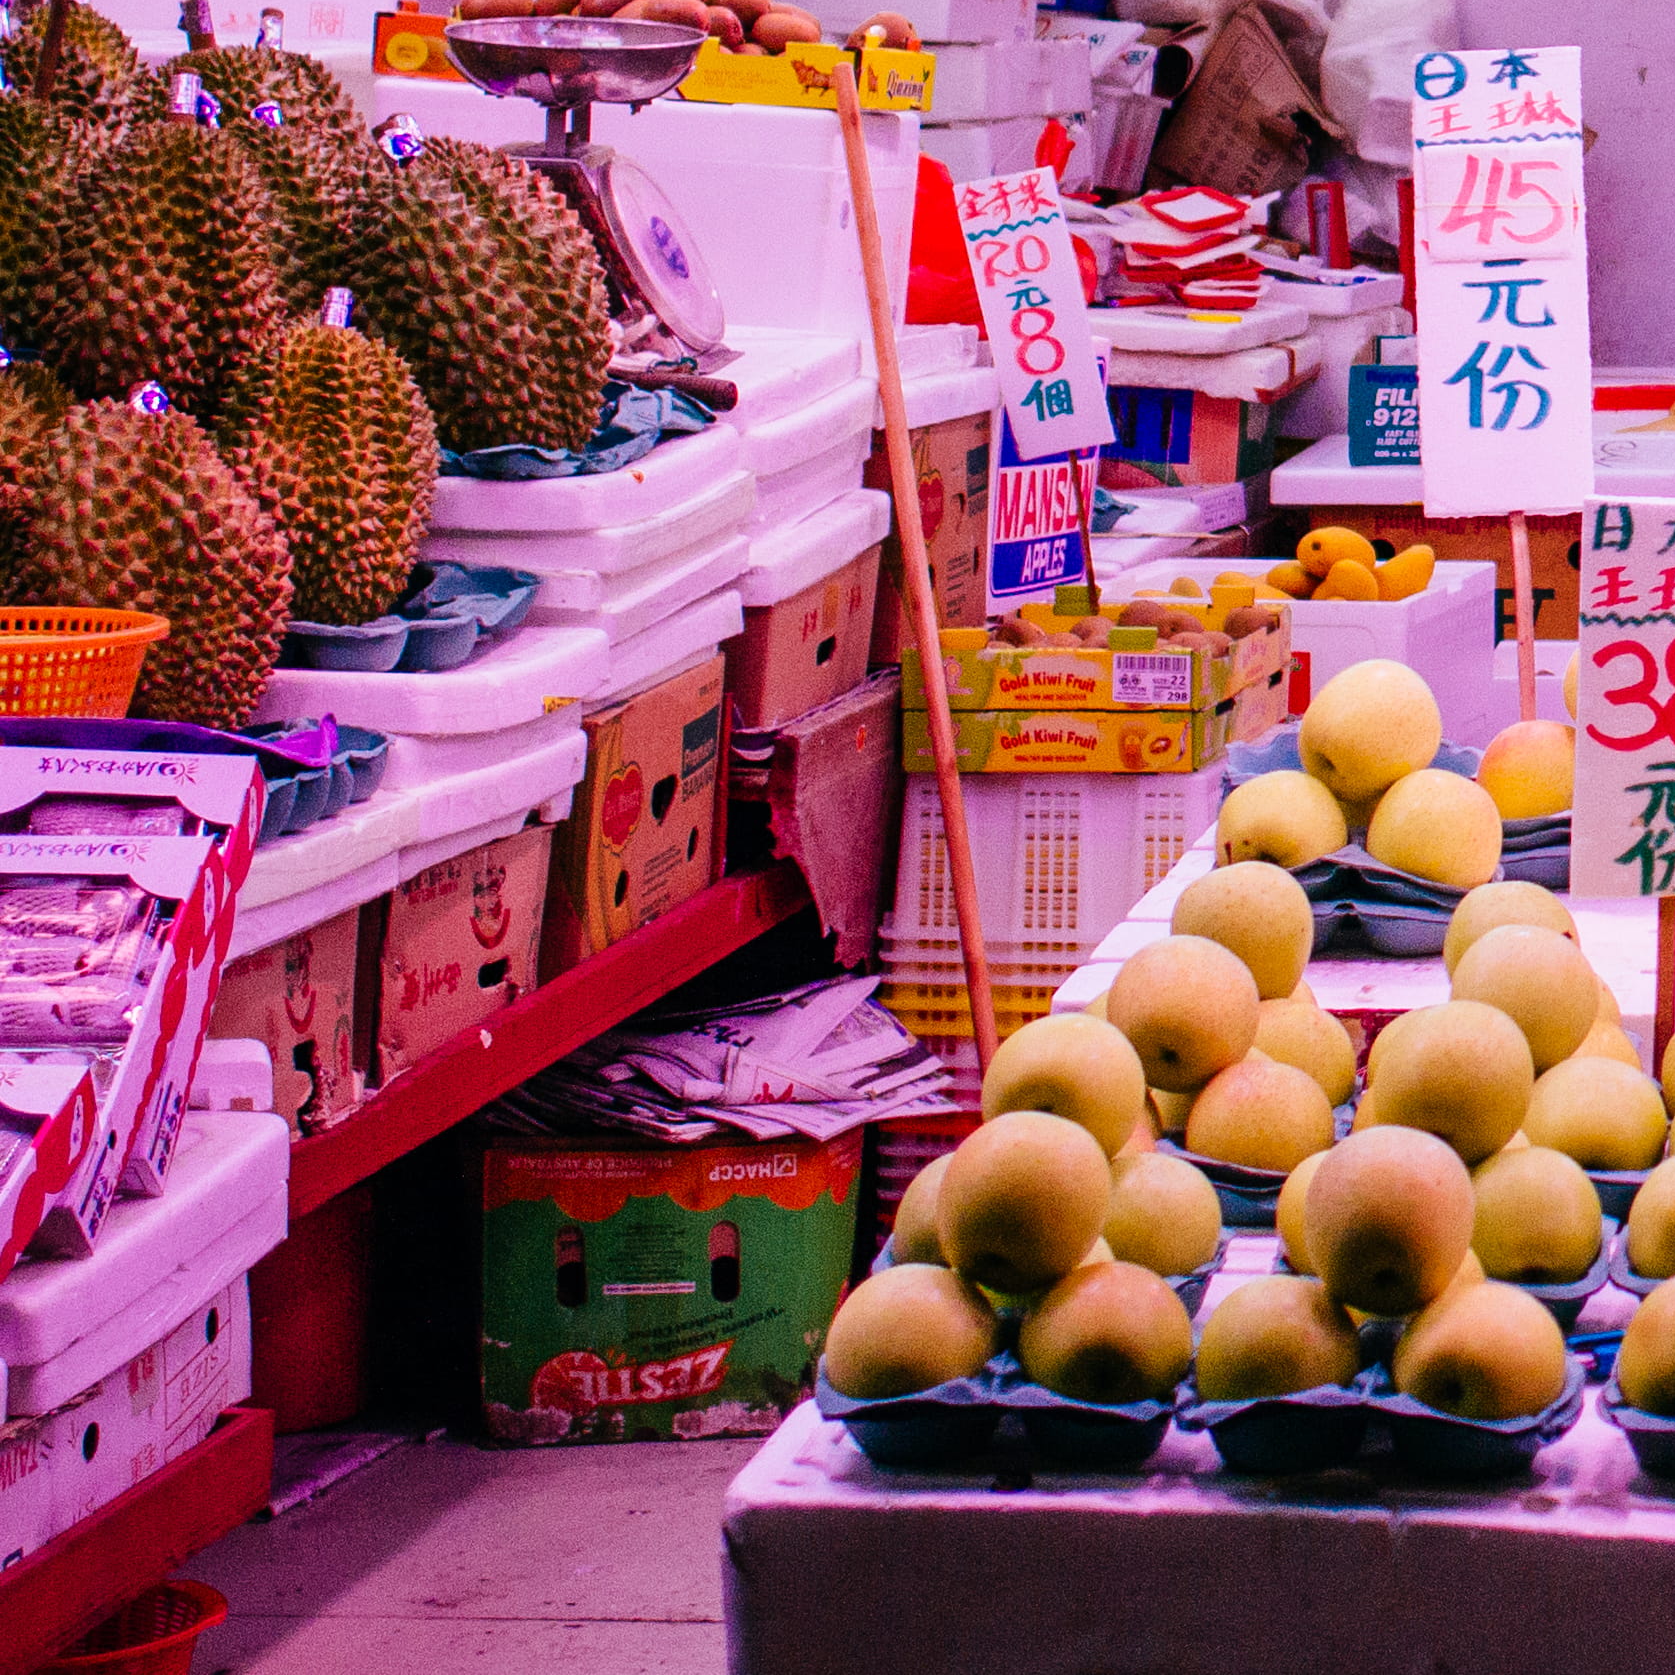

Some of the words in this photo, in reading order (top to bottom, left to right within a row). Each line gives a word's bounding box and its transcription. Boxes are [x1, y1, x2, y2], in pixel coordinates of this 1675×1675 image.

[1416, 50, 1540, 101] 日本
[1429, 99, 1575, 136] 王琳
[1439, 155, 1566, 248] 45
[1022, 539, 1067, 584] APPLES
[999, 673, 1030, 692] Gold
[1032, 671, 1062, 686] Kiwi
[1065, 673, 1096, 693] Fruit
[1171, 675, 1187, 686] 22
[1167, 691, 1188, 702] 298
[1000, 730, 1031, 751] Gold
[1033, 729, 1063, 744] Kiwi
[1066, 731, 1098, 751] Fruit
[709, 1162, 772, 1183] HACCP
